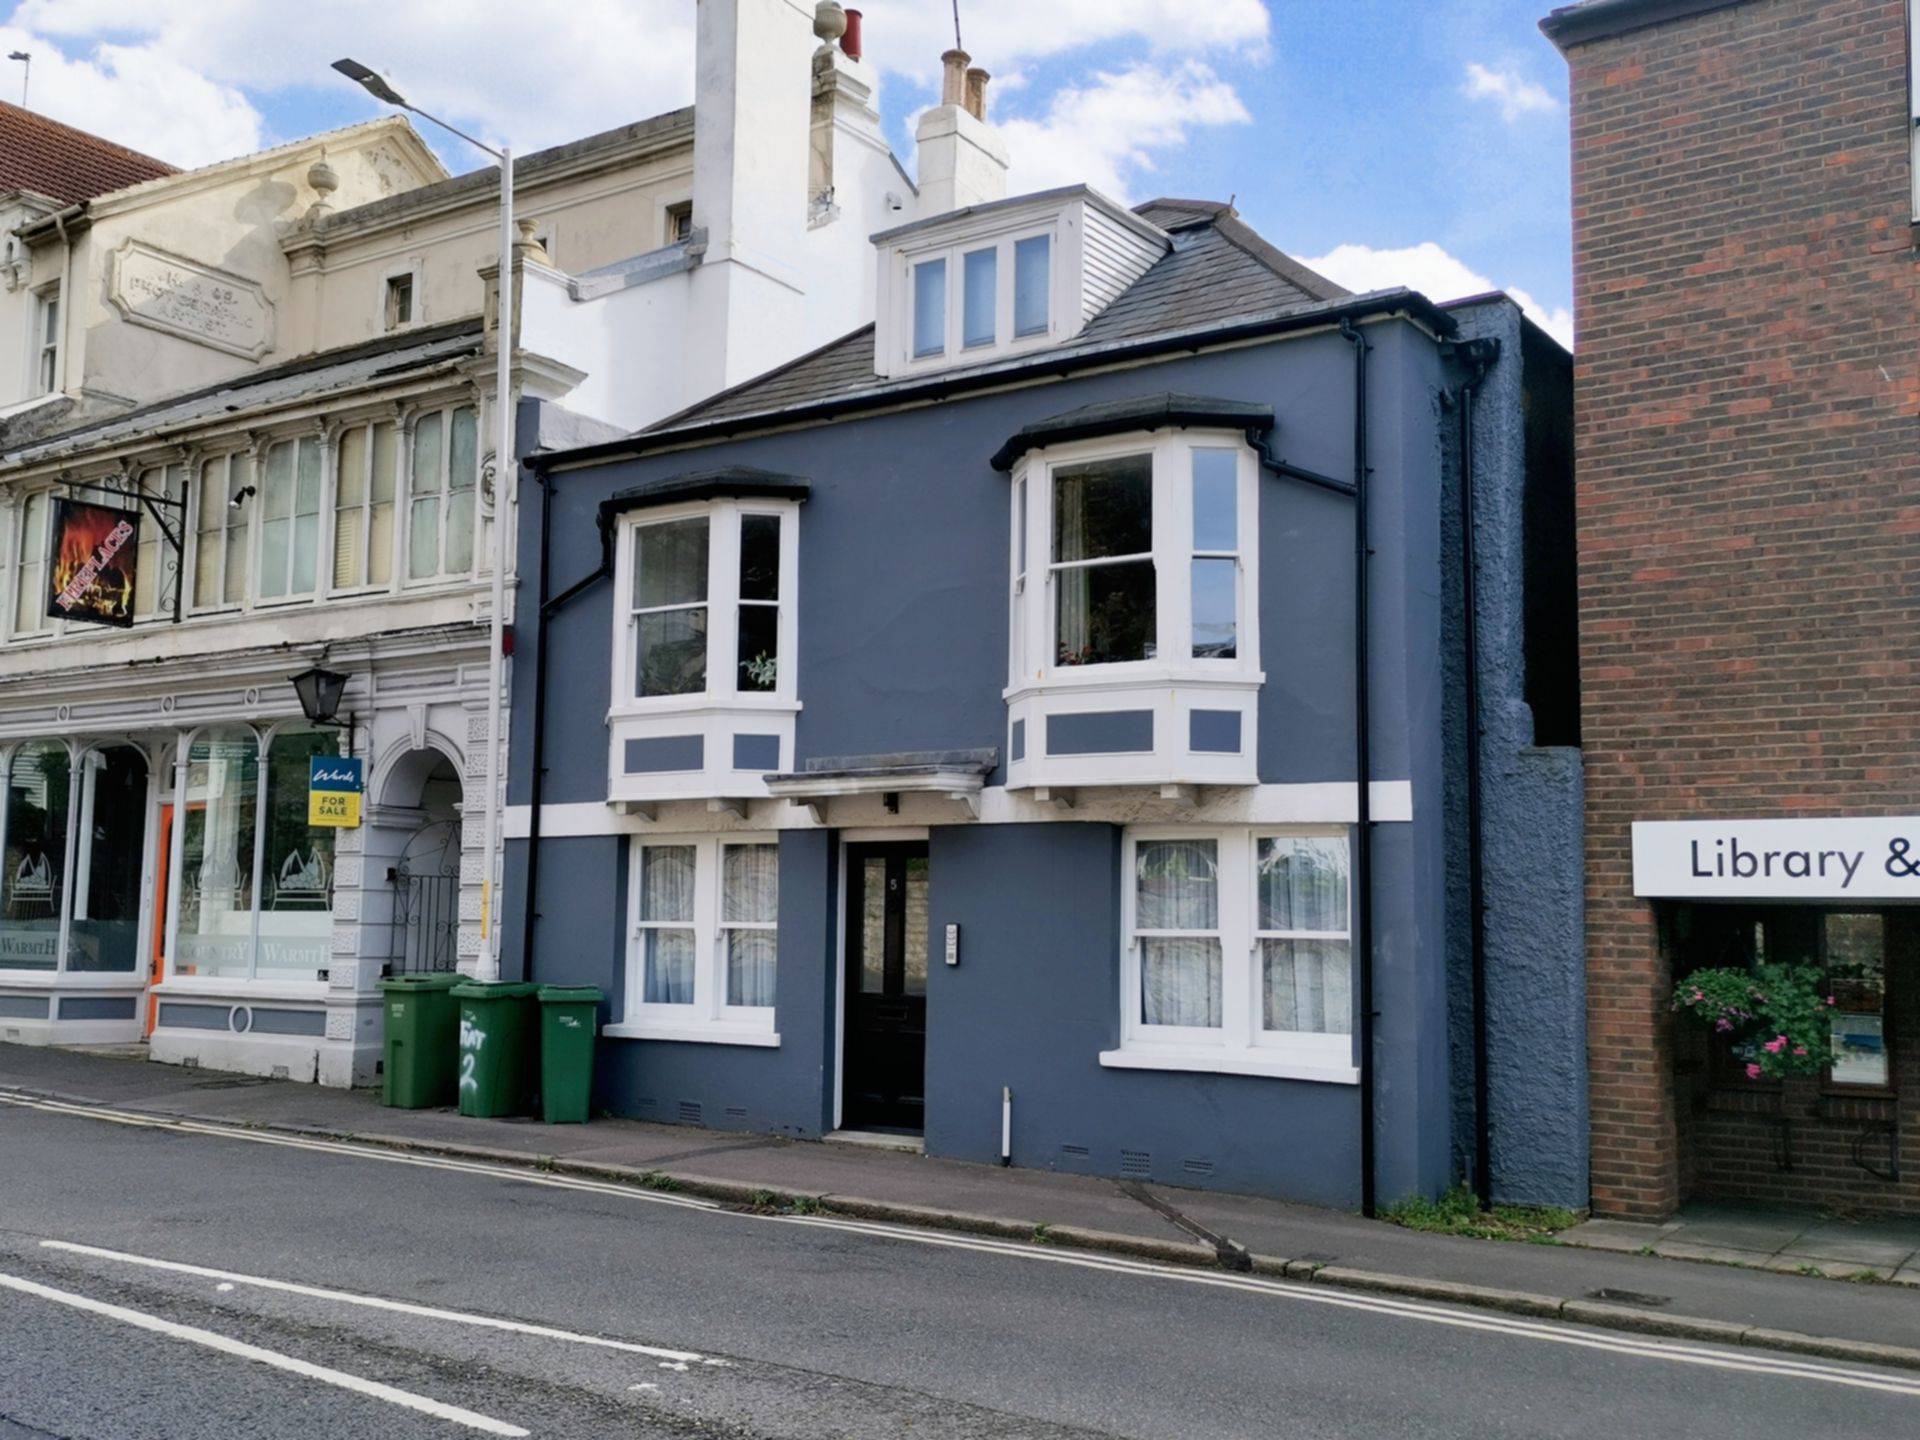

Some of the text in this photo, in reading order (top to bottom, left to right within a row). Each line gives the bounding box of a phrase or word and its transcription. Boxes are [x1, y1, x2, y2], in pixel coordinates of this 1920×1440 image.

[54, 519, 134, 612] FIREPLACES
[318, 806, 348, 816] SALE
[321, 796, 346, 806] FOR
[1691, 837, 1920, 888] Library &
[890, 879, 898, 890] 5
[459, 1053, 478, 1092] 2
